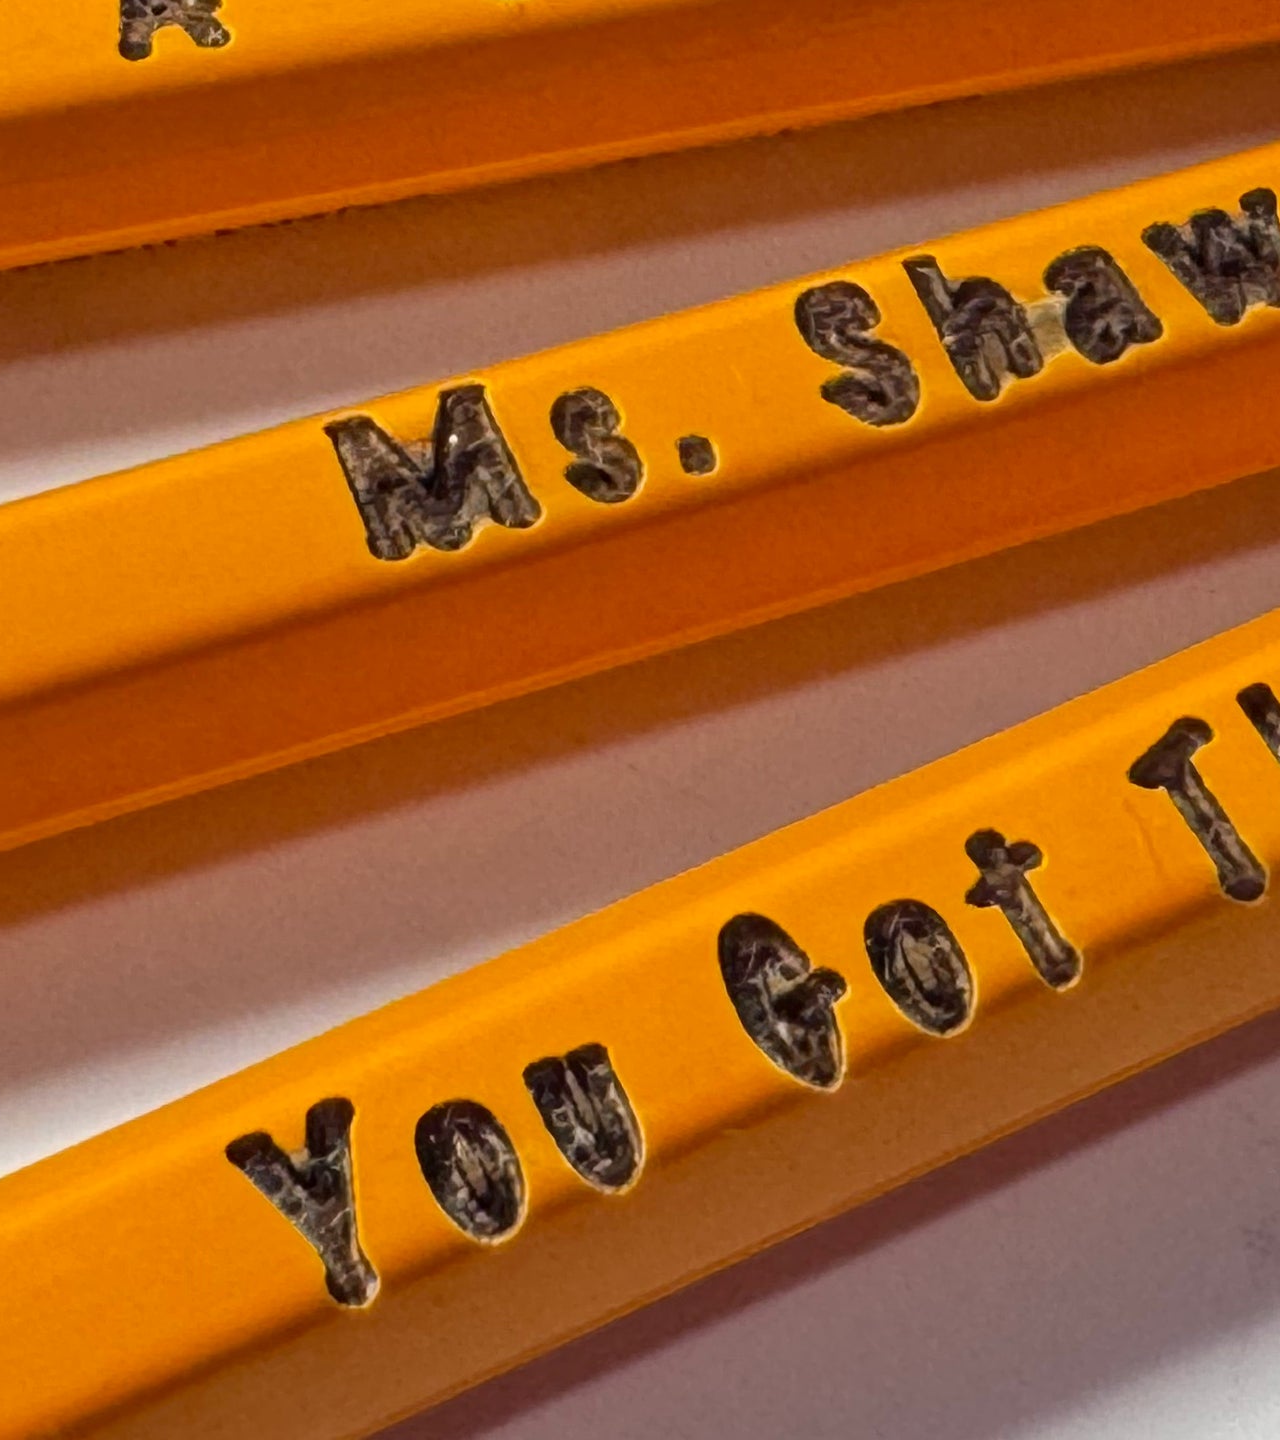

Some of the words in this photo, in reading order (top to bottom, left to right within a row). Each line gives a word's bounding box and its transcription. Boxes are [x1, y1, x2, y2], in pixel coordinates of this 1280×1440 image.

[324, 385, 718, 560] Ms.
[226, 1045, 645, 1310] You
[718, 830, 1081, 1087] Got
